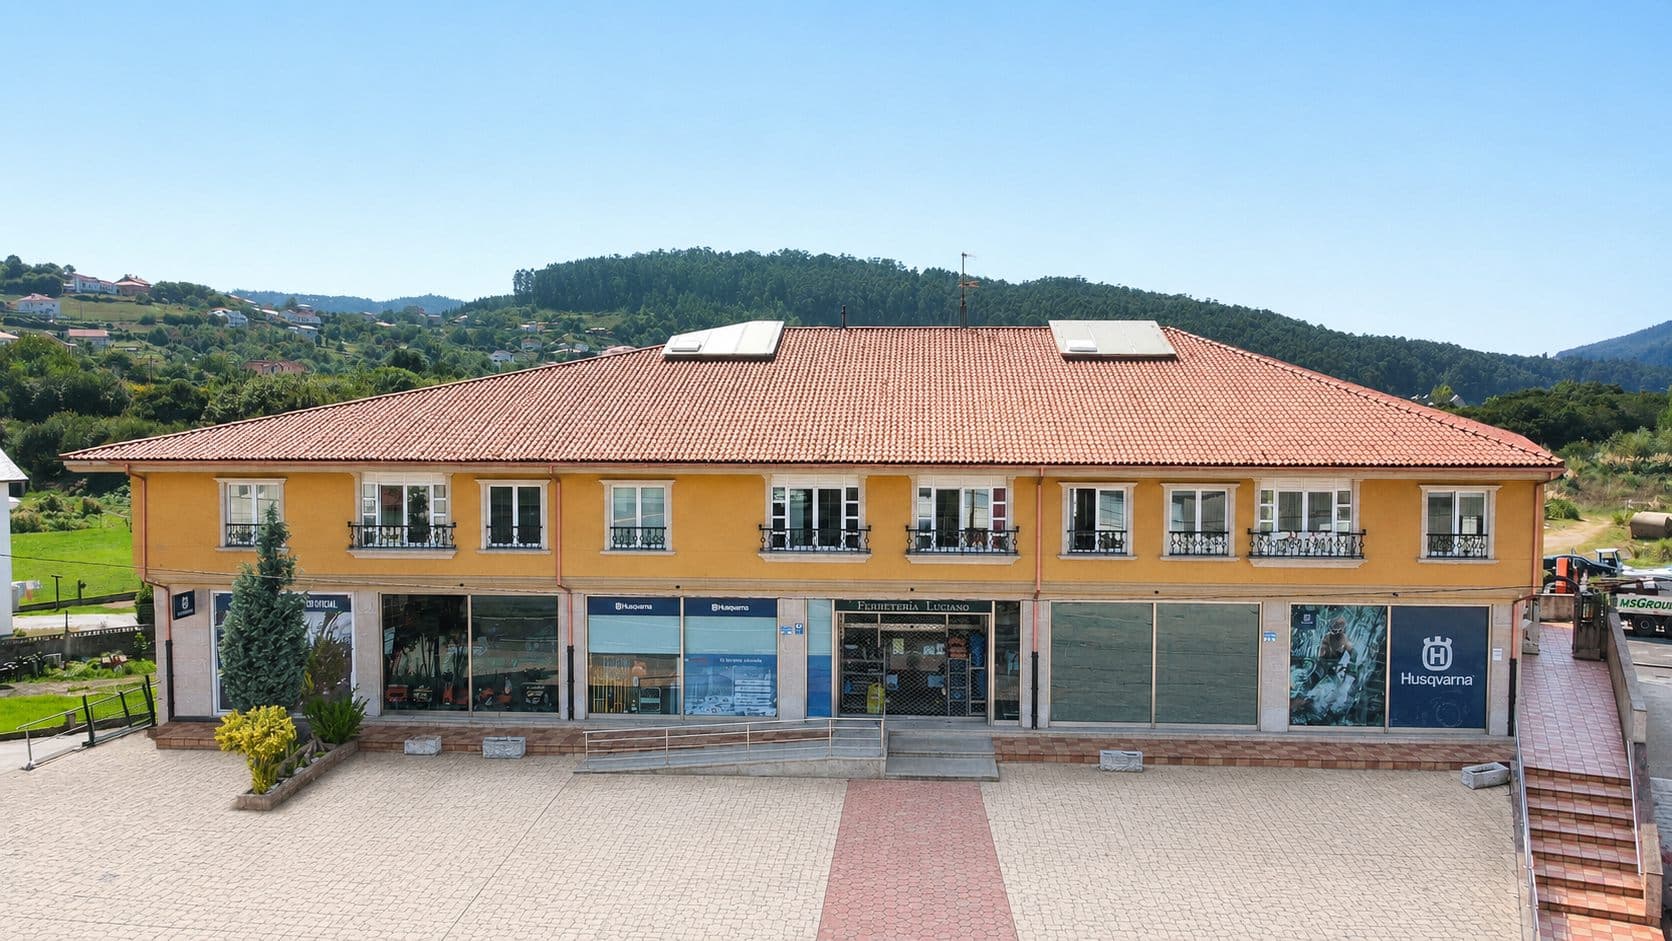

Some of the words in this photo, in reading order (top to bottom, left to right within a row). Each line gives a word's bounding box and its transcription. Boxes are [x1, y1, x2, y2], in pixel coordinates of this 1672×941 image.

[622, 602, 652, 611] Husqvarna
[718, 604, 749, 612] Husqvarna
[926, 601, 970, 612] LUCIANO
[1401, 672, 1473, 687] Husqvarna
